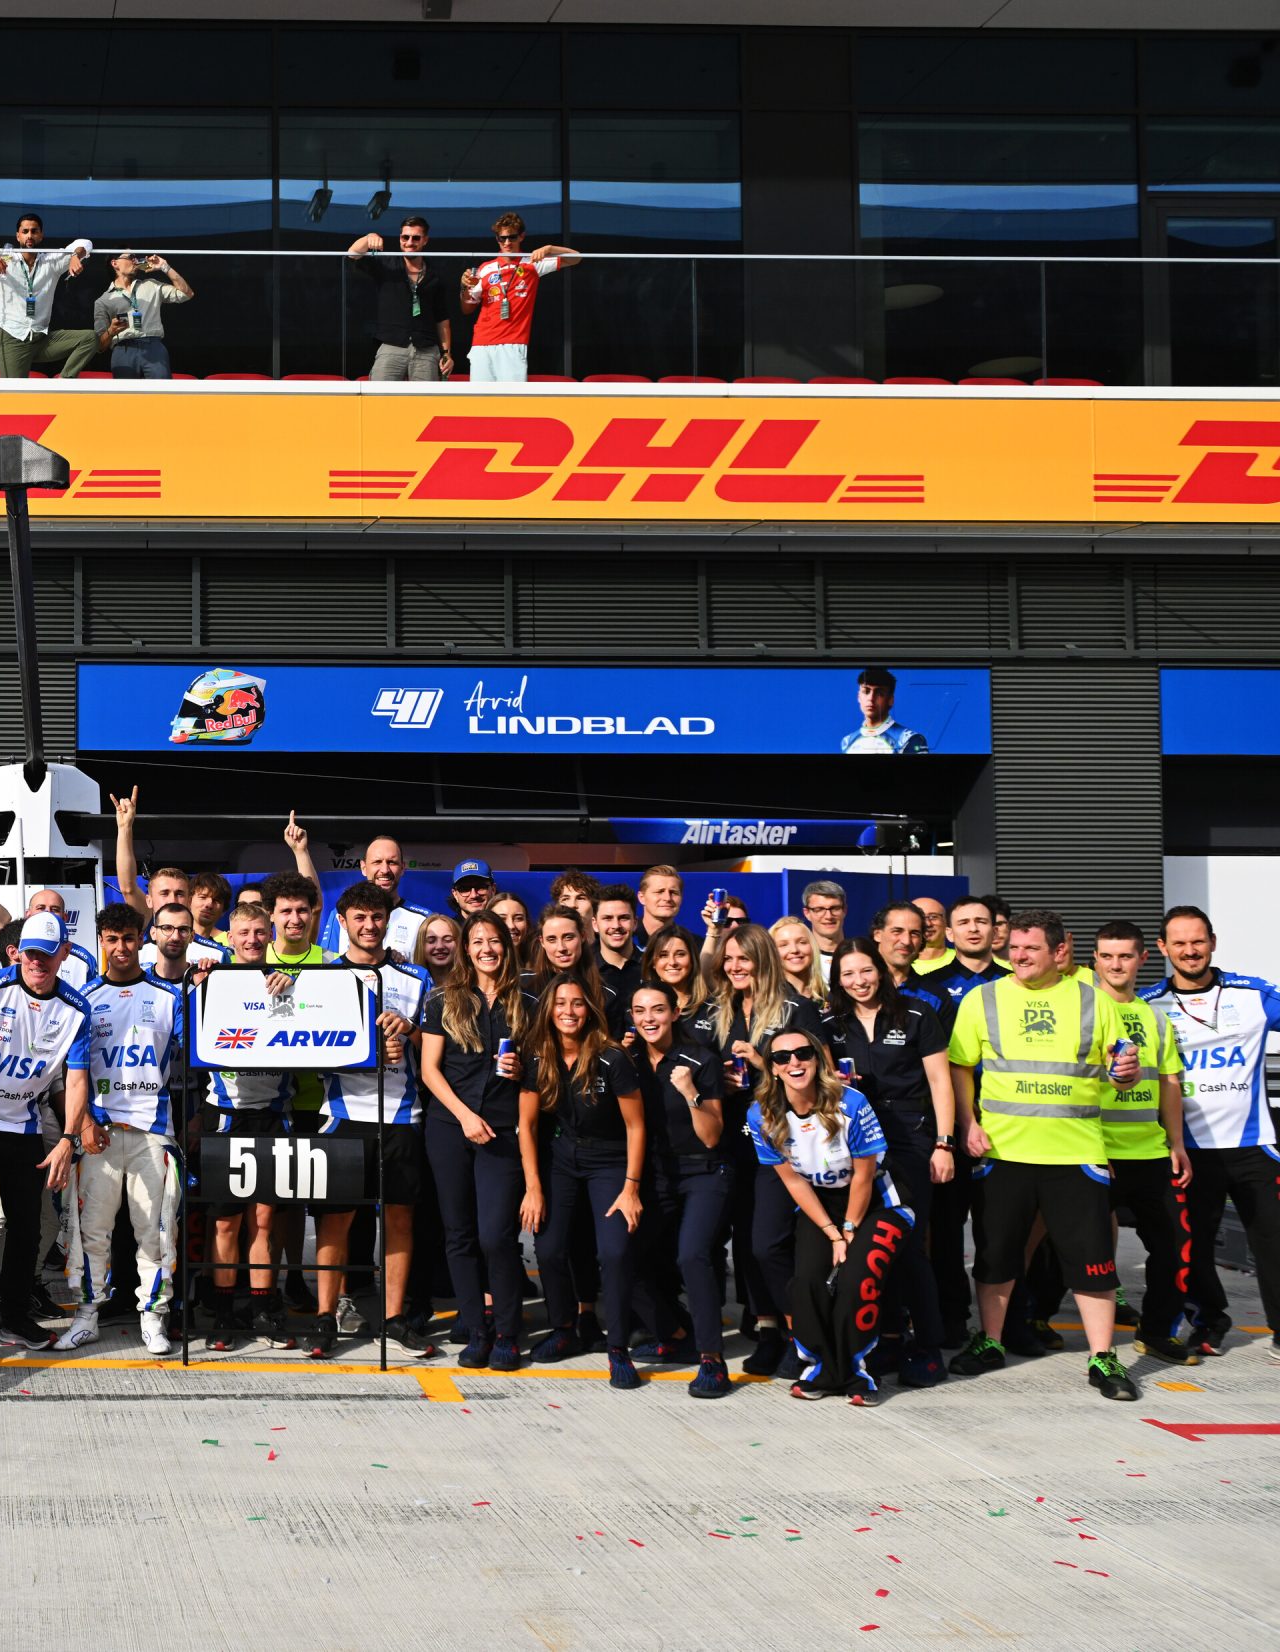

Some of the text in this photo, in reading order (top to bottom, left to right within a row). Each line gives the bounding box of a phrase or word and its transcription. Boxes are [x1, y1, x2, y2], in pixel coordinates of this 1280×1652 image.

[409, 415, 844, 502] DHL
[463, 675, 528, 719] Arvid
[205, 710, 257, 732] Red Bull
[469, 716, 715, 736] LINDBLAD
[681, 819, 798, 846] Airtasker
[332, 858, 361, 869] VISA
[396, 962, 419, 974] HUGO
[65, 991, 83, 1006] HUGO
[244, 1002, 265, 1010] VISA
[266, 1030, 357, 1047] ARVID
[99, 1045, 158, 1068] VISA
[1180, 1046, 1246, 1071] VISA
[113, 1081, 158, 1092] Cash App
[1016, 1080, 1072, 1096] Airtasker
[1199, 1082, 1249, 1093] Cash App
[20, 1091, 35, 1101] App
[229, 1138, 328, 1199] 5 th
[855, 1220, 902, 1331] HUGO
[1086, 1260, 1115, 1276] HUG
